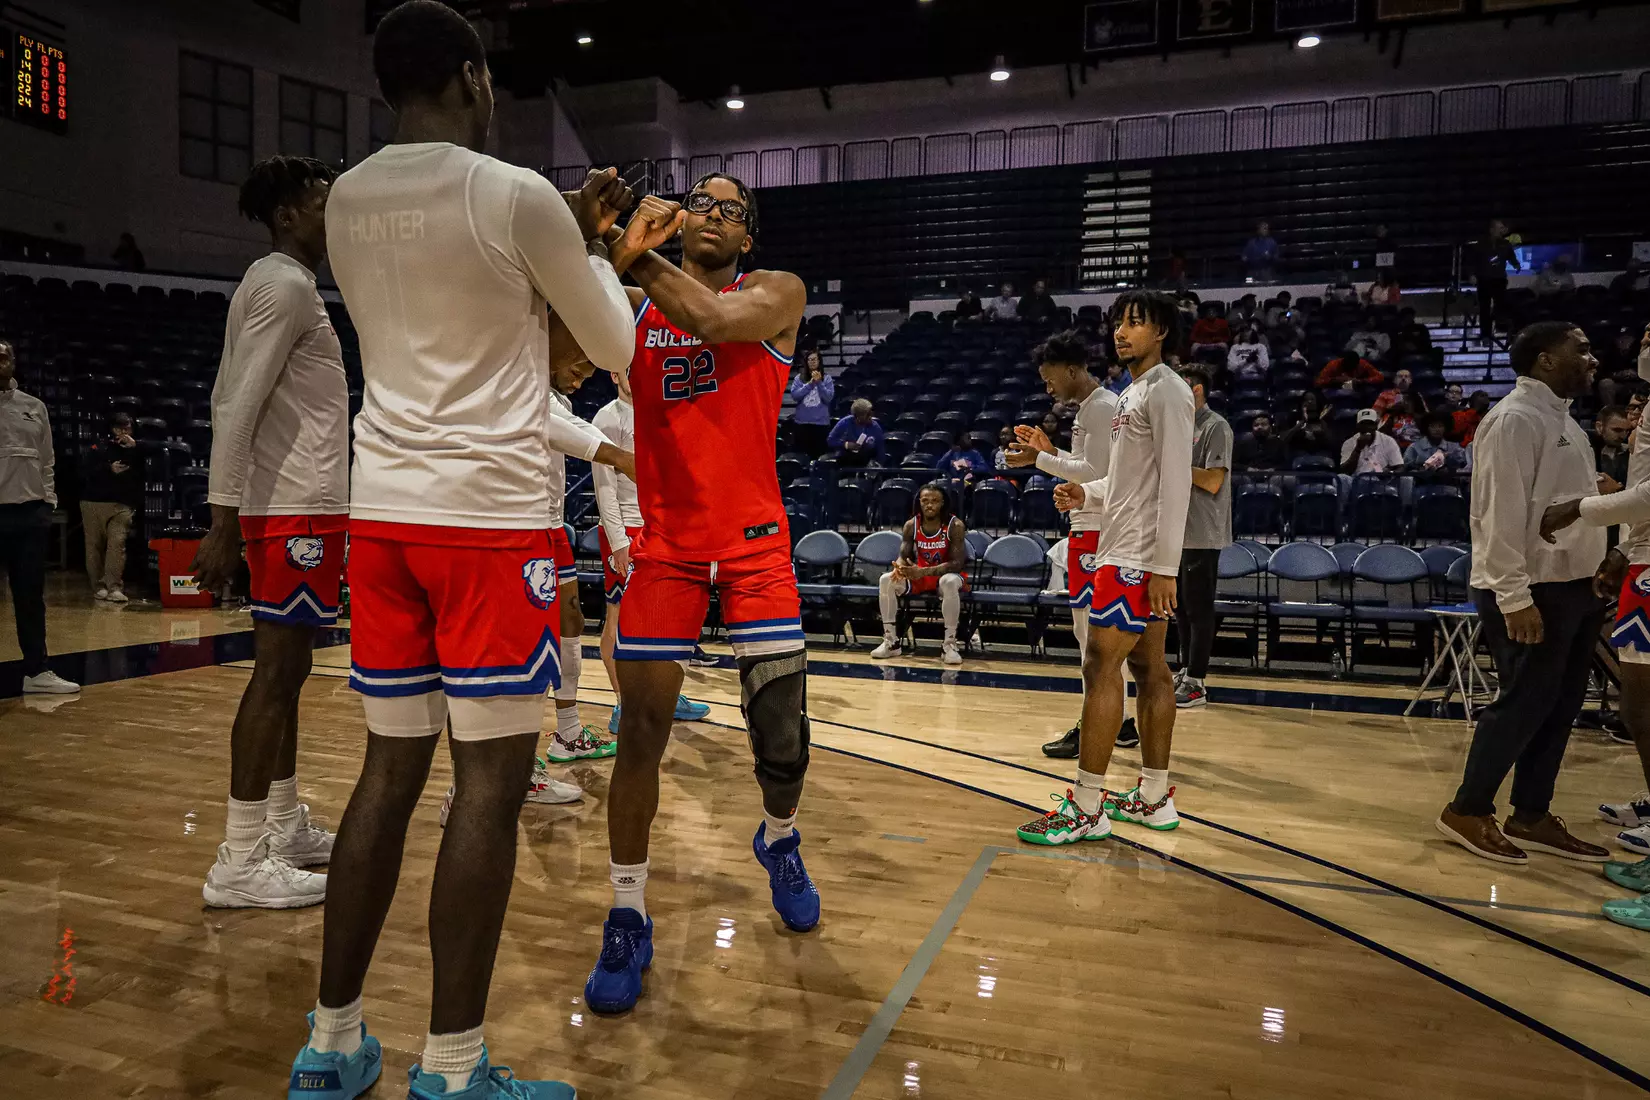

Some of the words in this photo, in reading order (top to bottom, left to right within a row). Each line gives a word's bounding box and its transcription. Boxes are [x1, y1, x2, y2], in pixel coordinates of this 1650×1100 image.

[20, 35, 34, 47] PLY
[37, 42, 46, 54] FL
[48, 46, 63, 59] PTS
[21, 59, 31, 71] 14
[41, 66, 49, 78] 0
[58, 73, 66, 84] 0
[25, 48, 31, 60] 0
[41, 55, 49, 66] 0
[58, 61, 66, 73] 0
[18, 70, 31, 84] 20
[41, 79, 49, 91] 0
[58, 85, 66, 96] 0
[18, 82, 31, 96] 22
[41, 91, 49, 102] 0
[58, 96, 66, 107] 0
[18, 95, 31, 107] 24
[41, 103, 49, 114] 0
[58, 108, 66, 119] 0
[350, 209, 425, 243] HUNTER
[662, 349, 718, 400] 22
